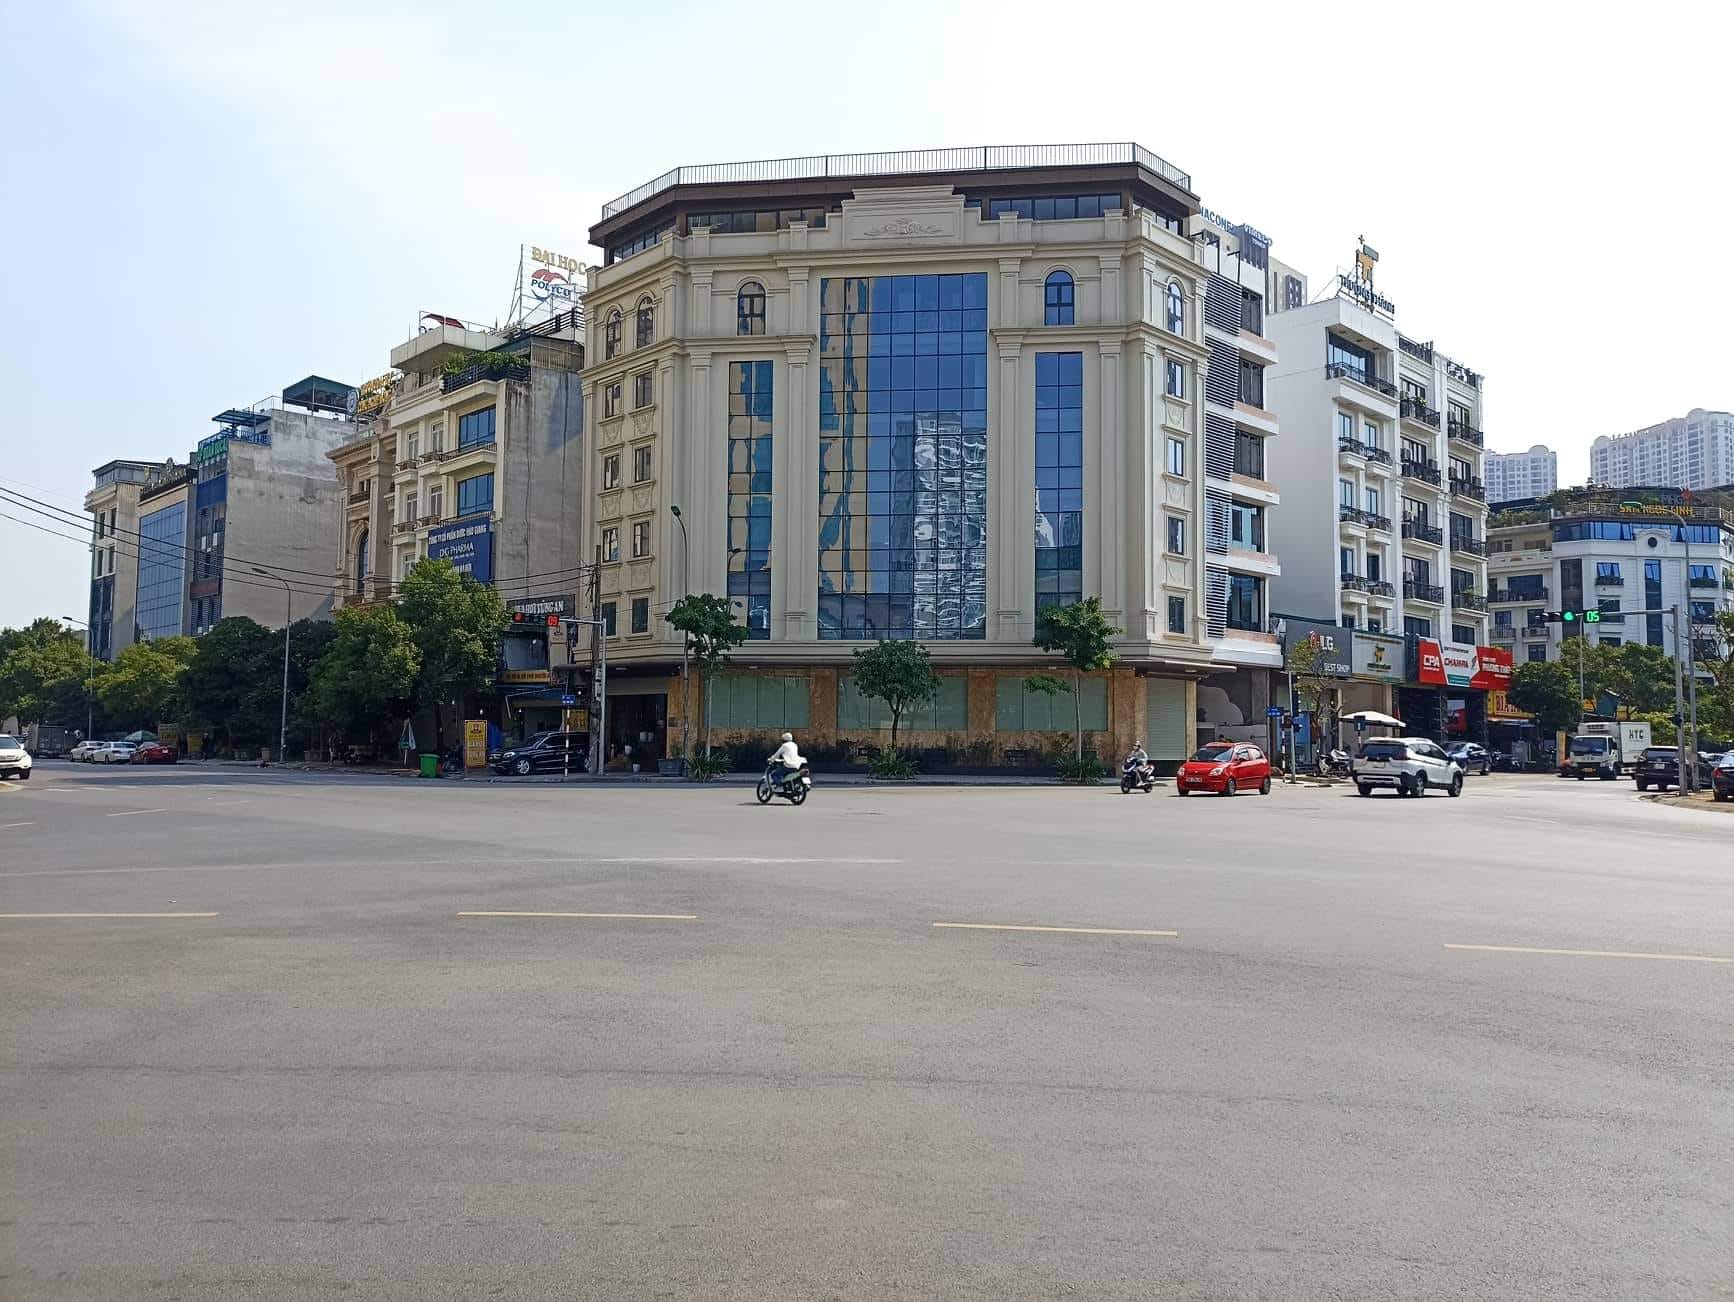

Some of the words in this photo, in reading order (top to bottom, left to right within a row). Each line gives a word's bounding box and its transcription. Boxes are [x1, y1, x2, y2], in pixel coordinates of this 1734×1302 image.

[548, 615, 558, 626] 09
[1586, 611, 1600, 622] 05
[1319, 635, 1334, 651] LG
